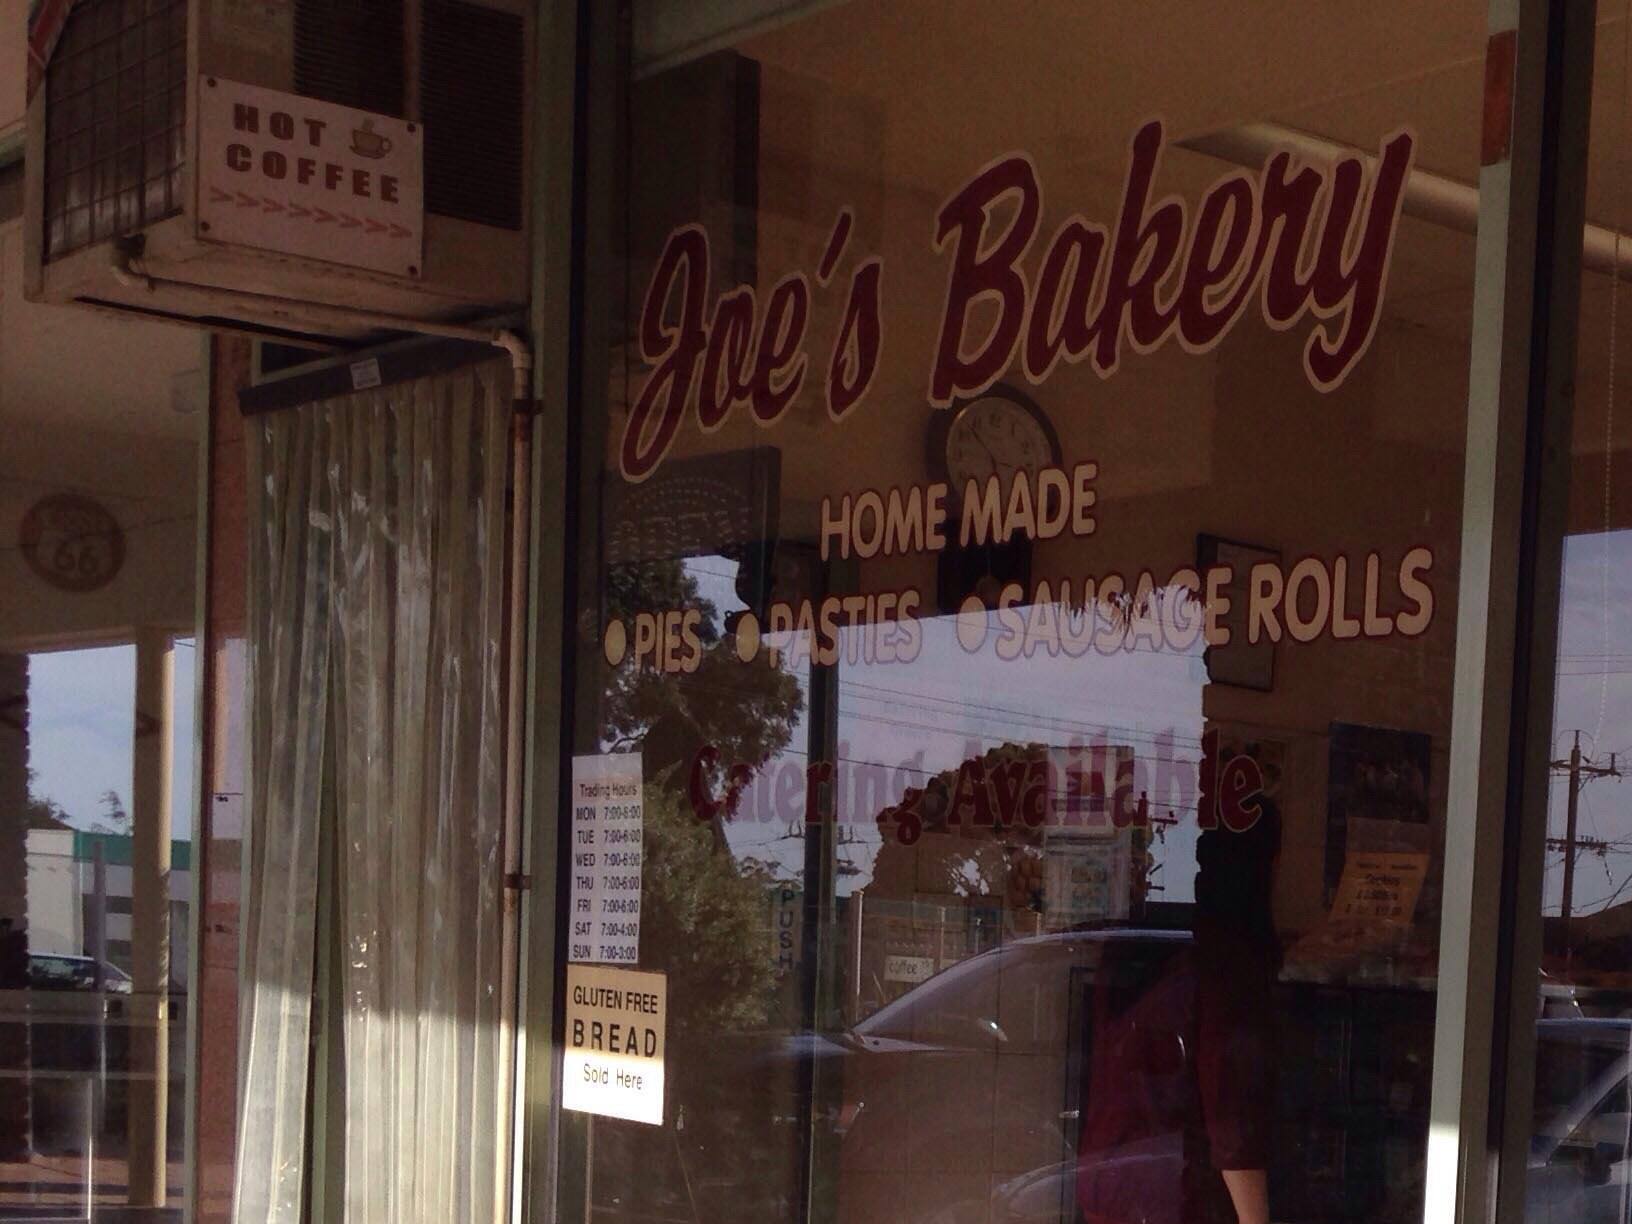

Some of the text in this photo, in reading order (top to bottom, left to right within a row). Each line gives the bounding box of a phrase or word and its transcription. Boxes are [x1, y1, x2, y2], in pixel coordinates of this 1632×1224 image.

[233, 103, 327, 147] HOT
[226, 143, 400, 204] COFFEE
[617, 121, 1415, 483] Joe's Bakery
[818, 462, 1099, 562] HOME MADE
[634, 547, 1435, 674] PIES PASTIES SAUSAGE ROLLS
[612, 781, 638, 797] Hours
[576, 806, 596, 821] MON
[577, 829, 594, 844] TUE
[576, 853, 596, 867] WED
[576, 876, 594, 890] THU
[577, 899, 592, 913] FRI
[574, 921, 592, 936] SAT
[573, 944, 592, 959] SUN
[573, 984, 659, 1015] GLUTEN FREE
[573, 1018, 658, 1059] BREAD
[583, 1062, 643, 1090] Sold Here
